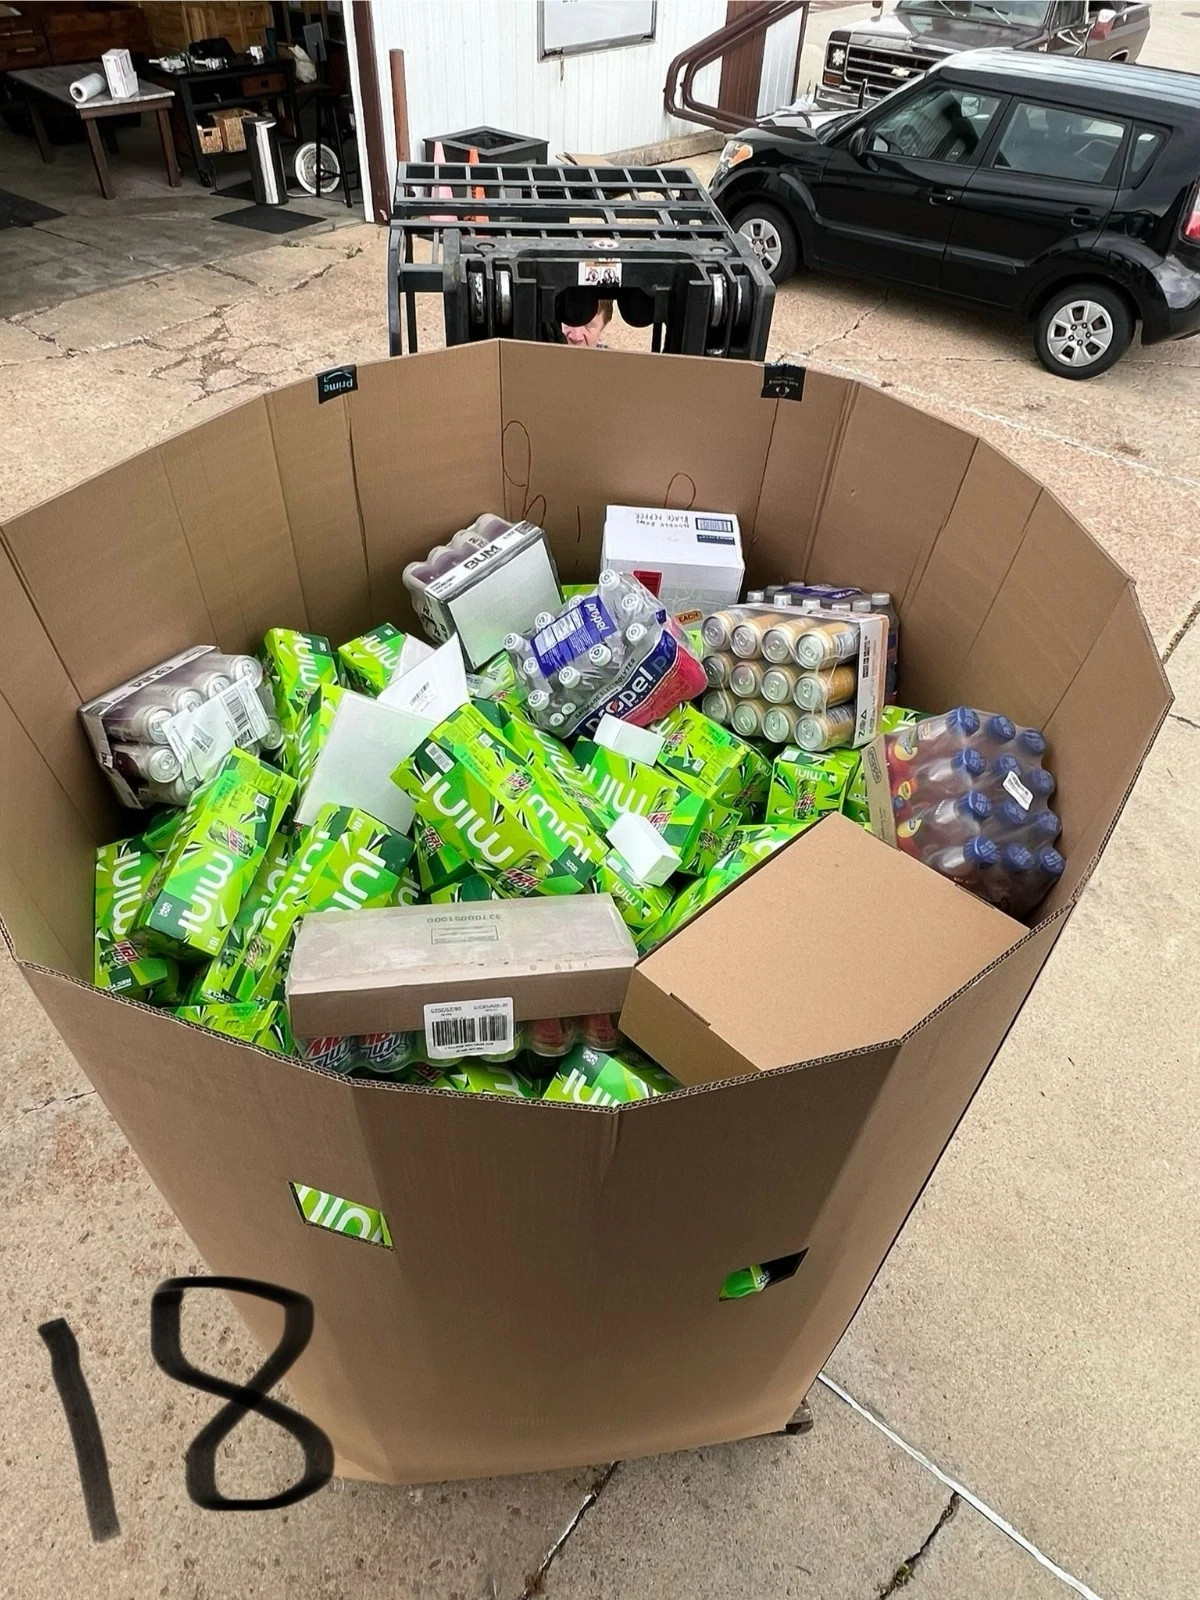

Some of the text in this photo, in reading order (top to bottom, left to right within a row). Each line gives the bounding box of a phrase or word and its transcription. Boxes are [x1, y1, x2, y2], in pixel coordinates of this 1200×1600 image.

[324, 379, 353, 393] prime
[463, 544, 500, 571] BUM
[584, 602, 611, 634] propel
[678, 612, 699, 623] EACH
[600, 658, 636, 697] ELECTROLYTES
[421, 771, 514, 864] mini
[527, 793, 593, 864] mini
[177, 851, 234, 934] mini
[265, 829, 331, 931] mini
[324, 847, 387, 912] ini
[612, 881, 639, 906] mini
[430, 1006, 463, 1015] 08/25/2025
